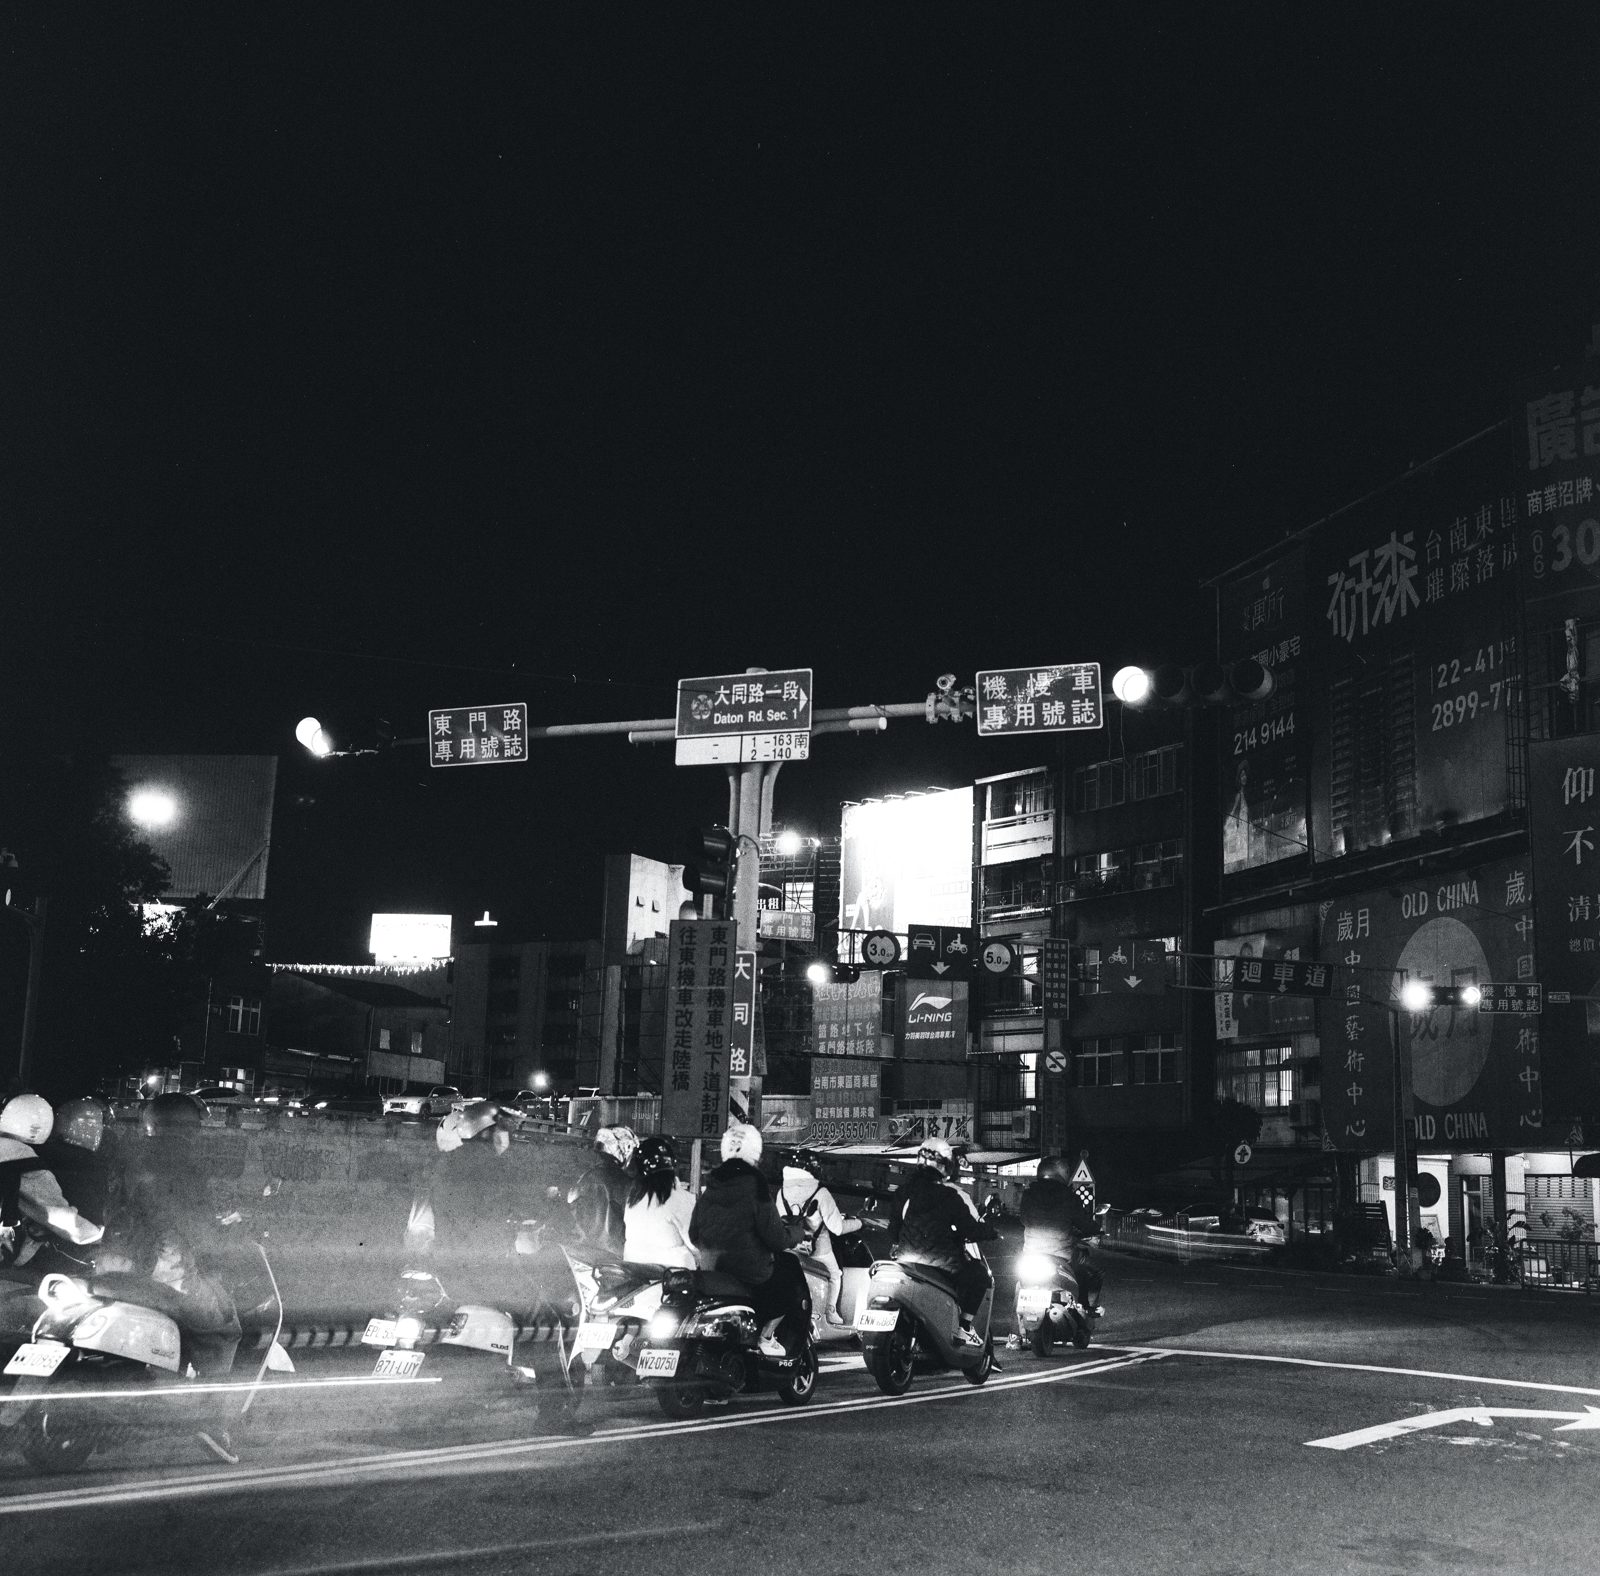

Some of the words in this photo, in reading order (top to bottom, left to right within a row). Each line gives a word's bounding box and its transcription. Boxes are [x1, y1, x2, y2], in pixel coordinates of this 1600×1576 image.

[713, 680, 799, 706] 大同路一段
[982, 669, 1096, 700] 機慢車
[433, 708, 522, 736] 東門路
[713, 712, 744, 725] Daton
[748, 710, 764, 723] Rd.
[767, 708, 788, 721] Sec.
[793, 708, 798, 720] 1
[982, 698, 1097, 729] 專用號誌
[434, 734, 523, 762] 專用號誌
[1401, 891, 1429, 919] OLD
[1436, 879, 1479, 912] CHINA
[1504, 869, 1532, 907] 歲
[1336, 907, 1370, 942] 歲月
[1240, 961, 1327, 988] 迴車道
[1480, 985, 1539, 997] 機慢車
[671, 926, 698, 1092] 往東機車改走陸橋
[908, 1012, 953, 1024] LI-NING
[700, 926, 728, 1134] 東門路機車地下道封閉
[810, 1120, 879, 1141] 0929-355017
[1443, 1111, 1489, 1140] CHINA
